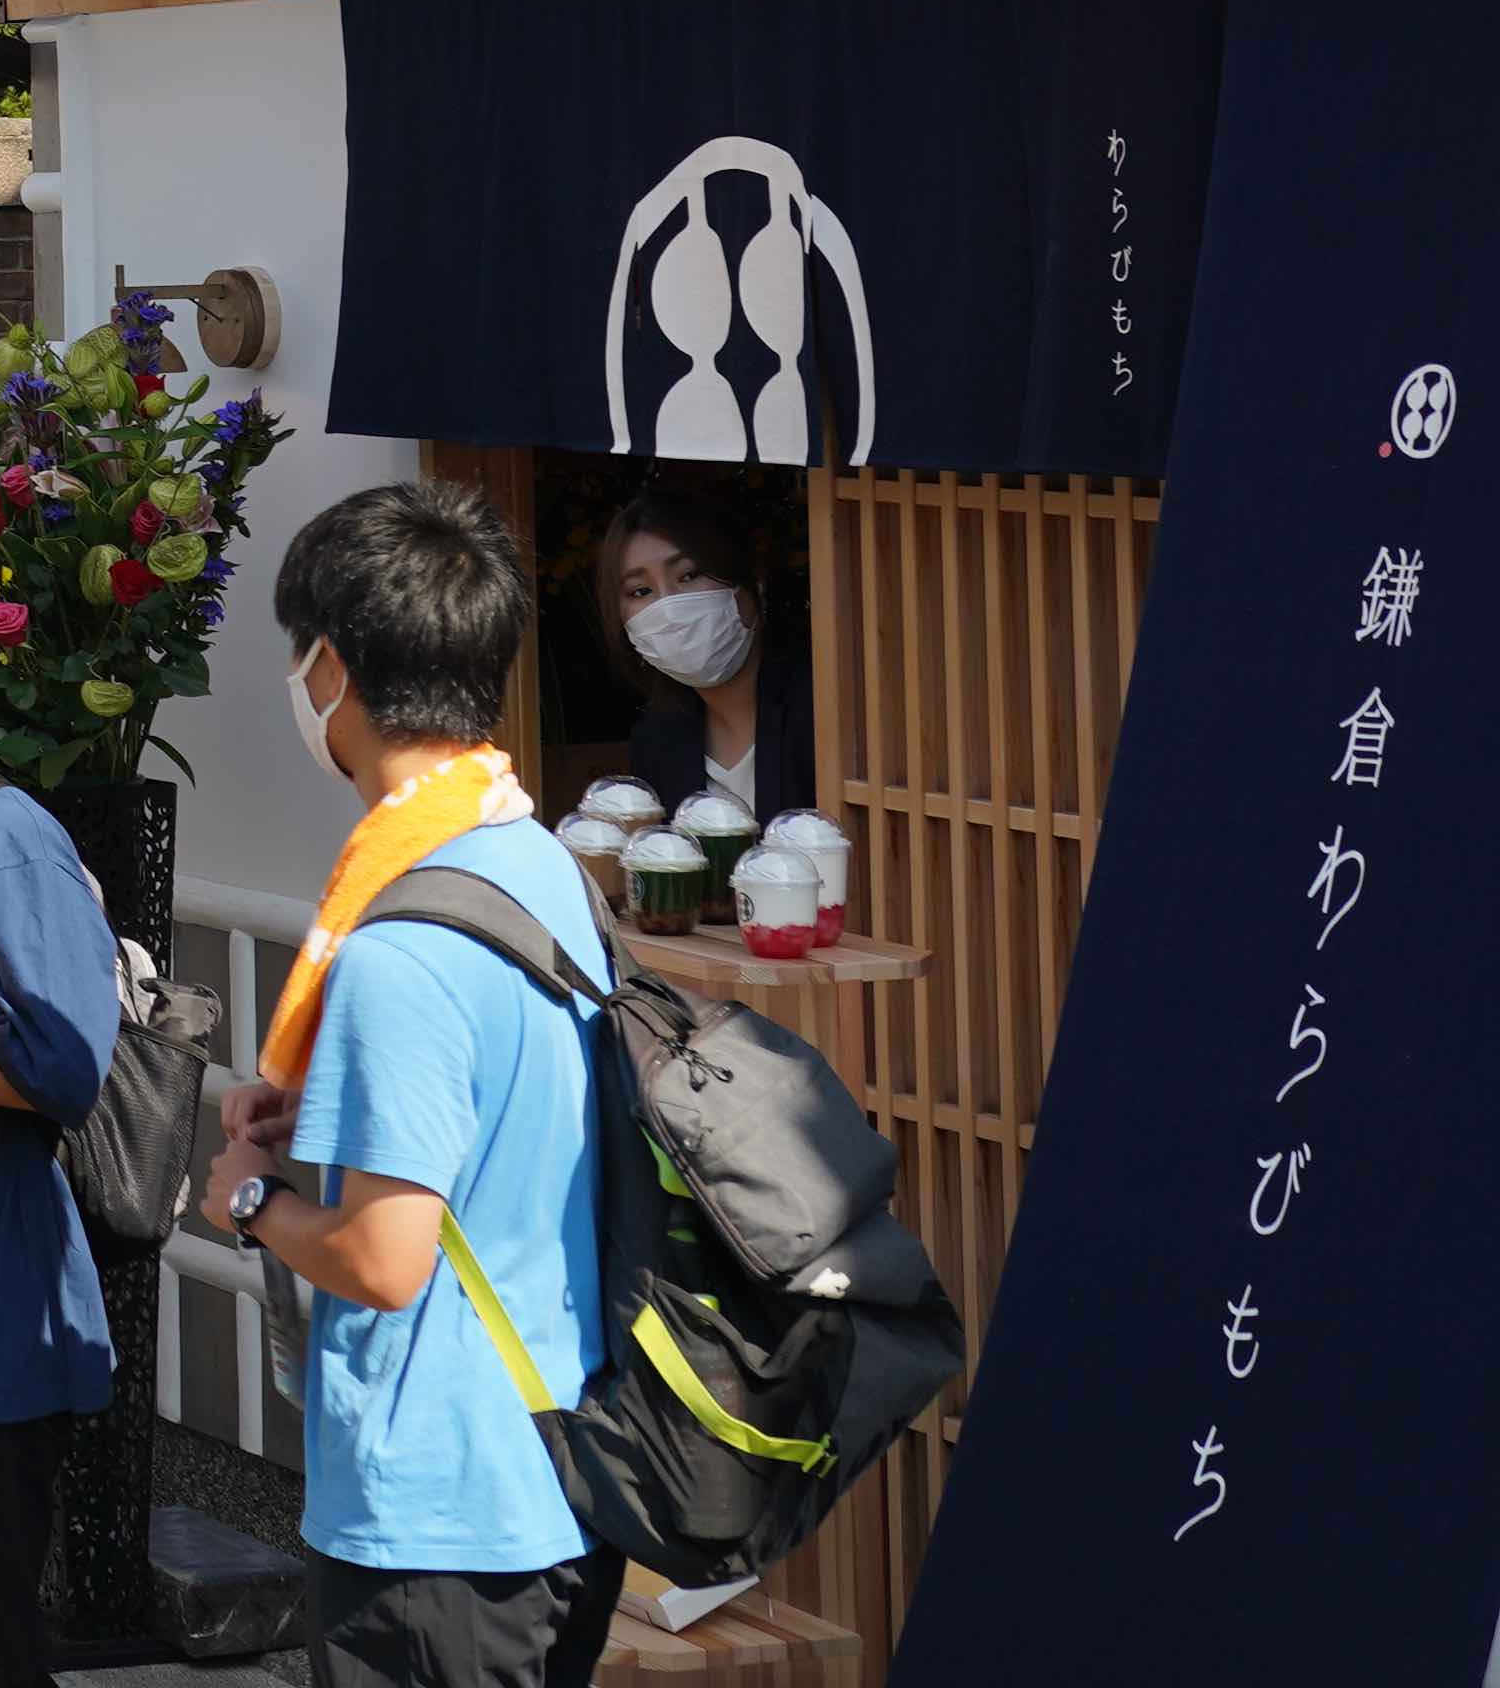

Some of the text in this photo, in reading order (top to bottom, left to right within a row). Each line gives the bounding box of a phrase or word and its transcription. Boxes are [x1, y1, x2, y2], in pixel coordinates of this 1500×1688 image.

[1105, 127, 1134, 397] わらびもち
[1174, 546, 1425, 1542] 鎌倉わらびもち
